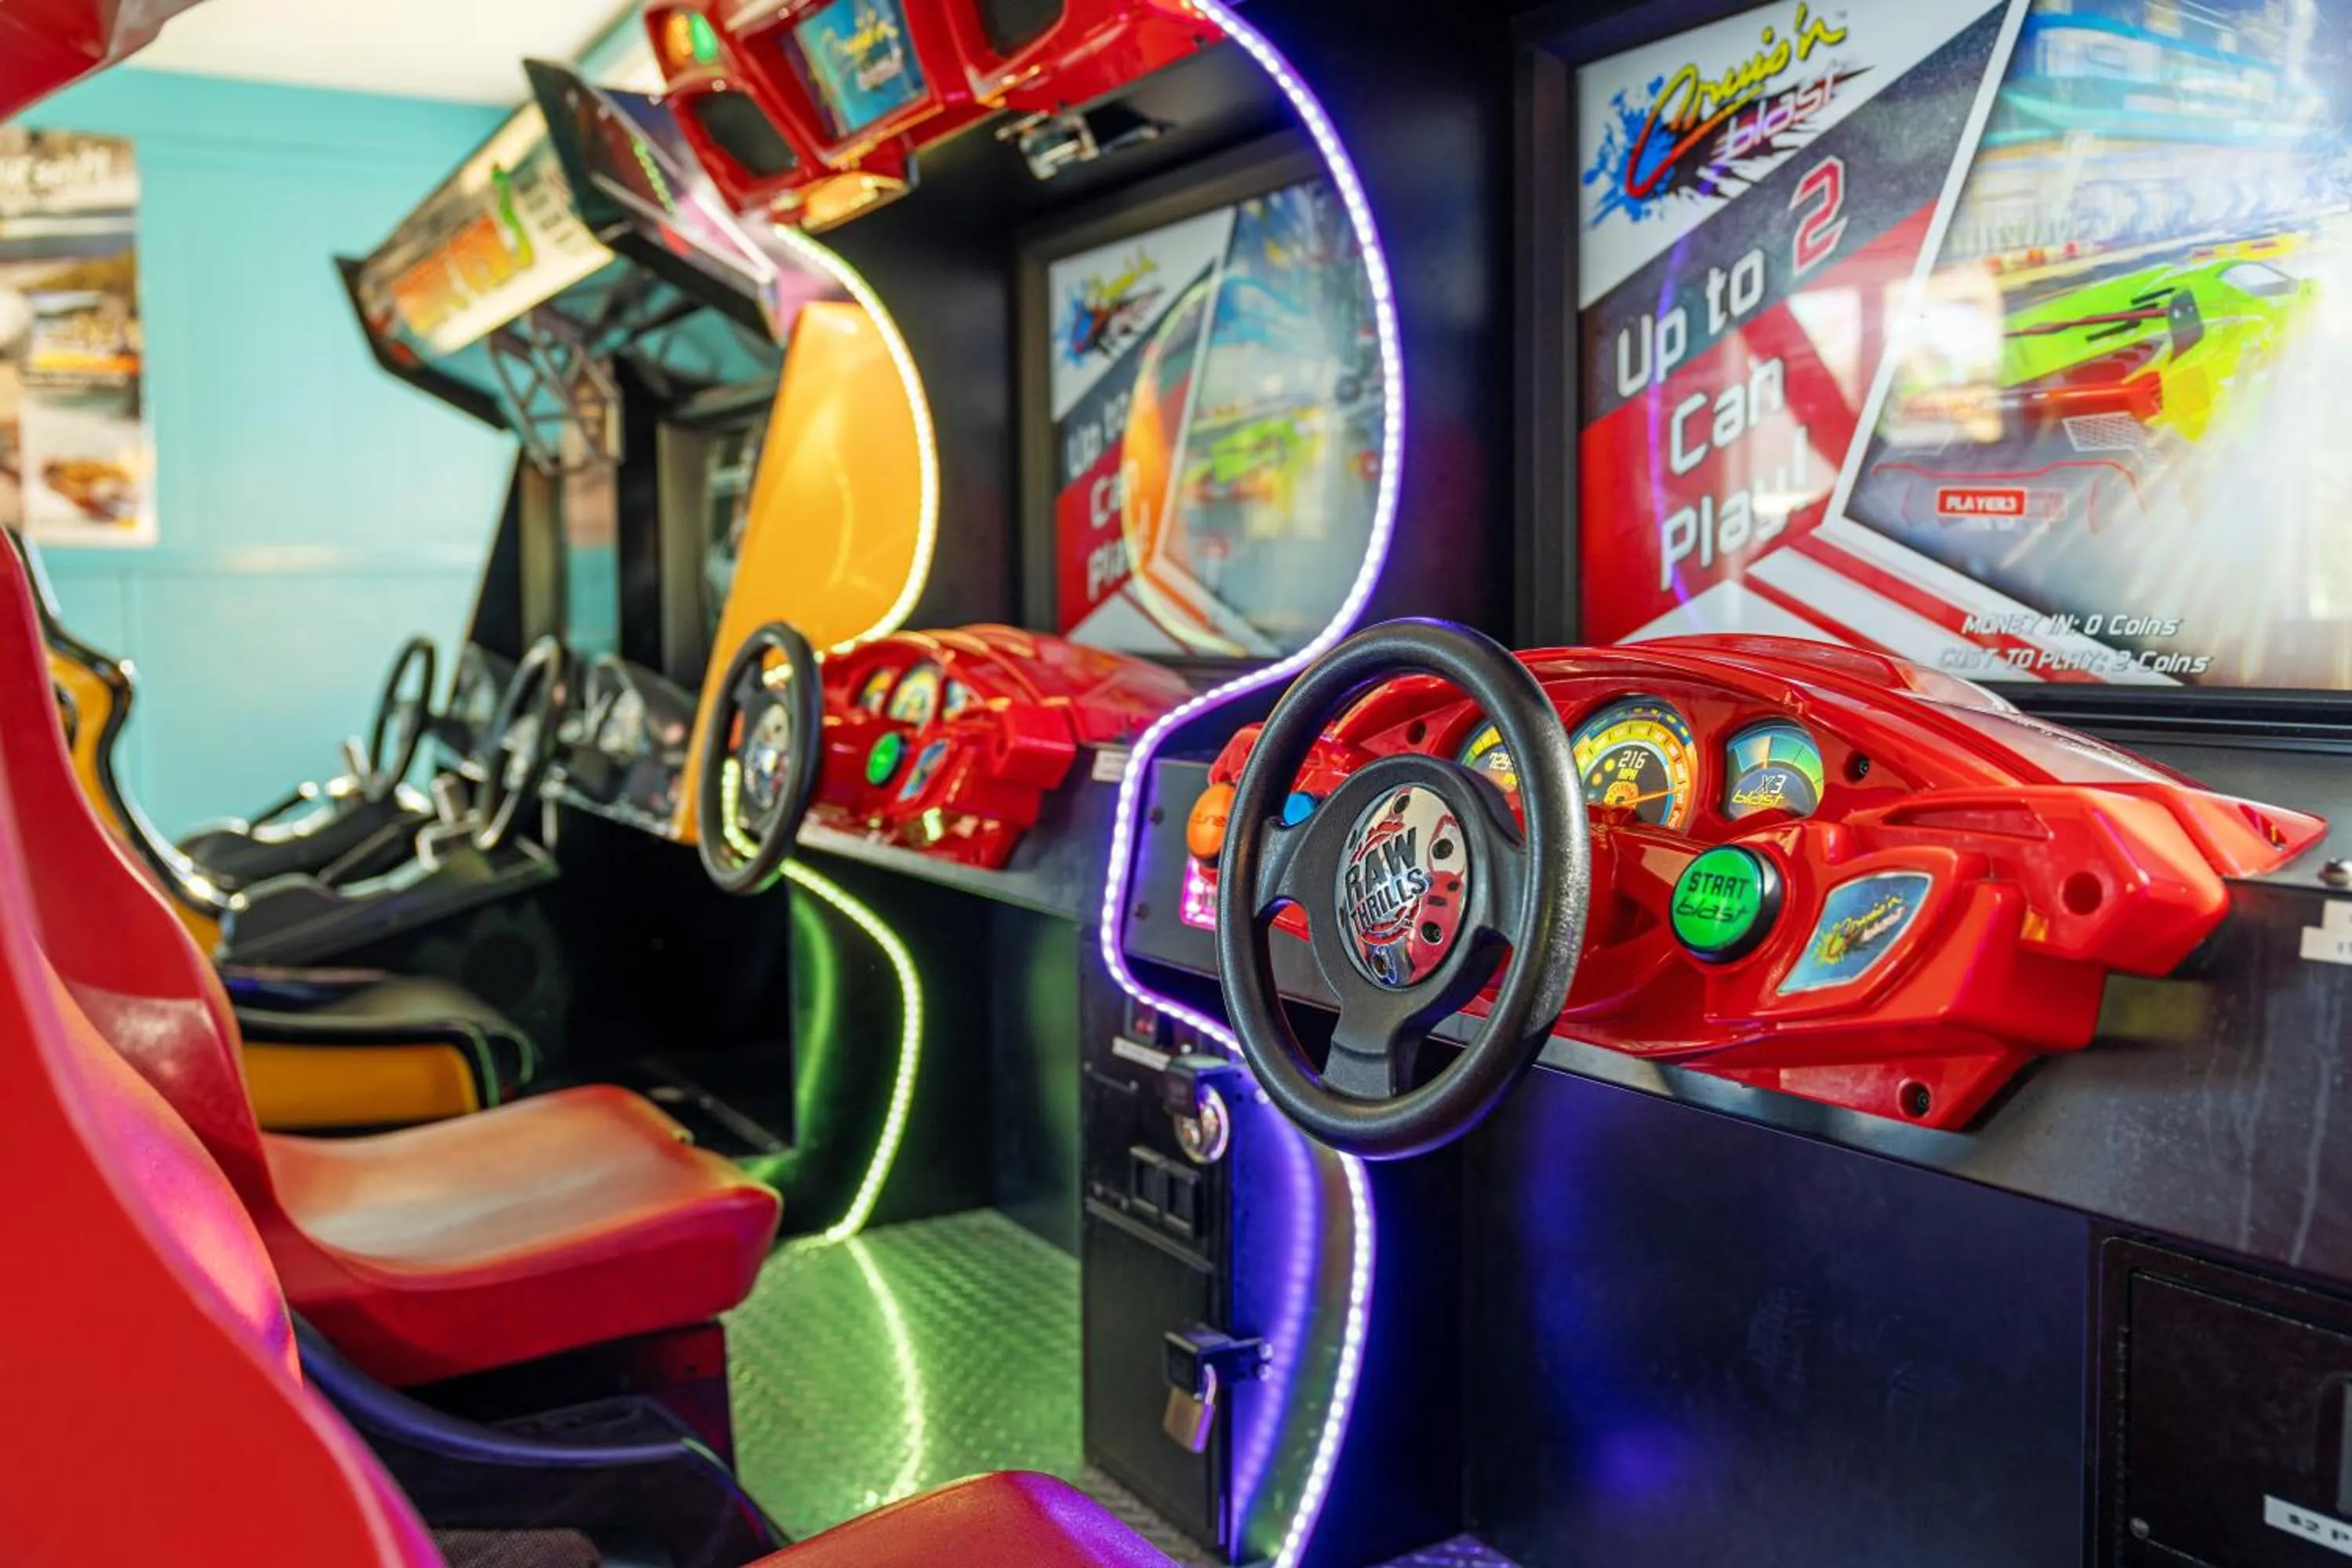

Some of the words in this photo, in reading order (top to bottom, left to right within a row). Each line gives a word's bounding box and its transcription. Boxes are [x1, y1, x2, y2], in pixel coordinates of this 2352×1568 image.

[1625, 2, 1848, 199] Cruis'n
[1618, 306, 1687, 397] Up
[1705, 248, 1765, 336] to
[1788, 155, 1848, 276] 2
[1670, 356, 1784, 475] Can
[1962, 615, 2040, 636] MONEY
[2048, 614, 2081, 638] IN:
[2108, 615, 2180, 636] Coins
[2005, 649, 2034, 668] TO
[2136, 652, 2213, 673] Coins
[1617, 750, 1649, 769] 216
[1345, 827, 1417, 908] RAW
[1687, 872, 1750, 899] START
[1351, 868, 1428, 936] THRILLS
